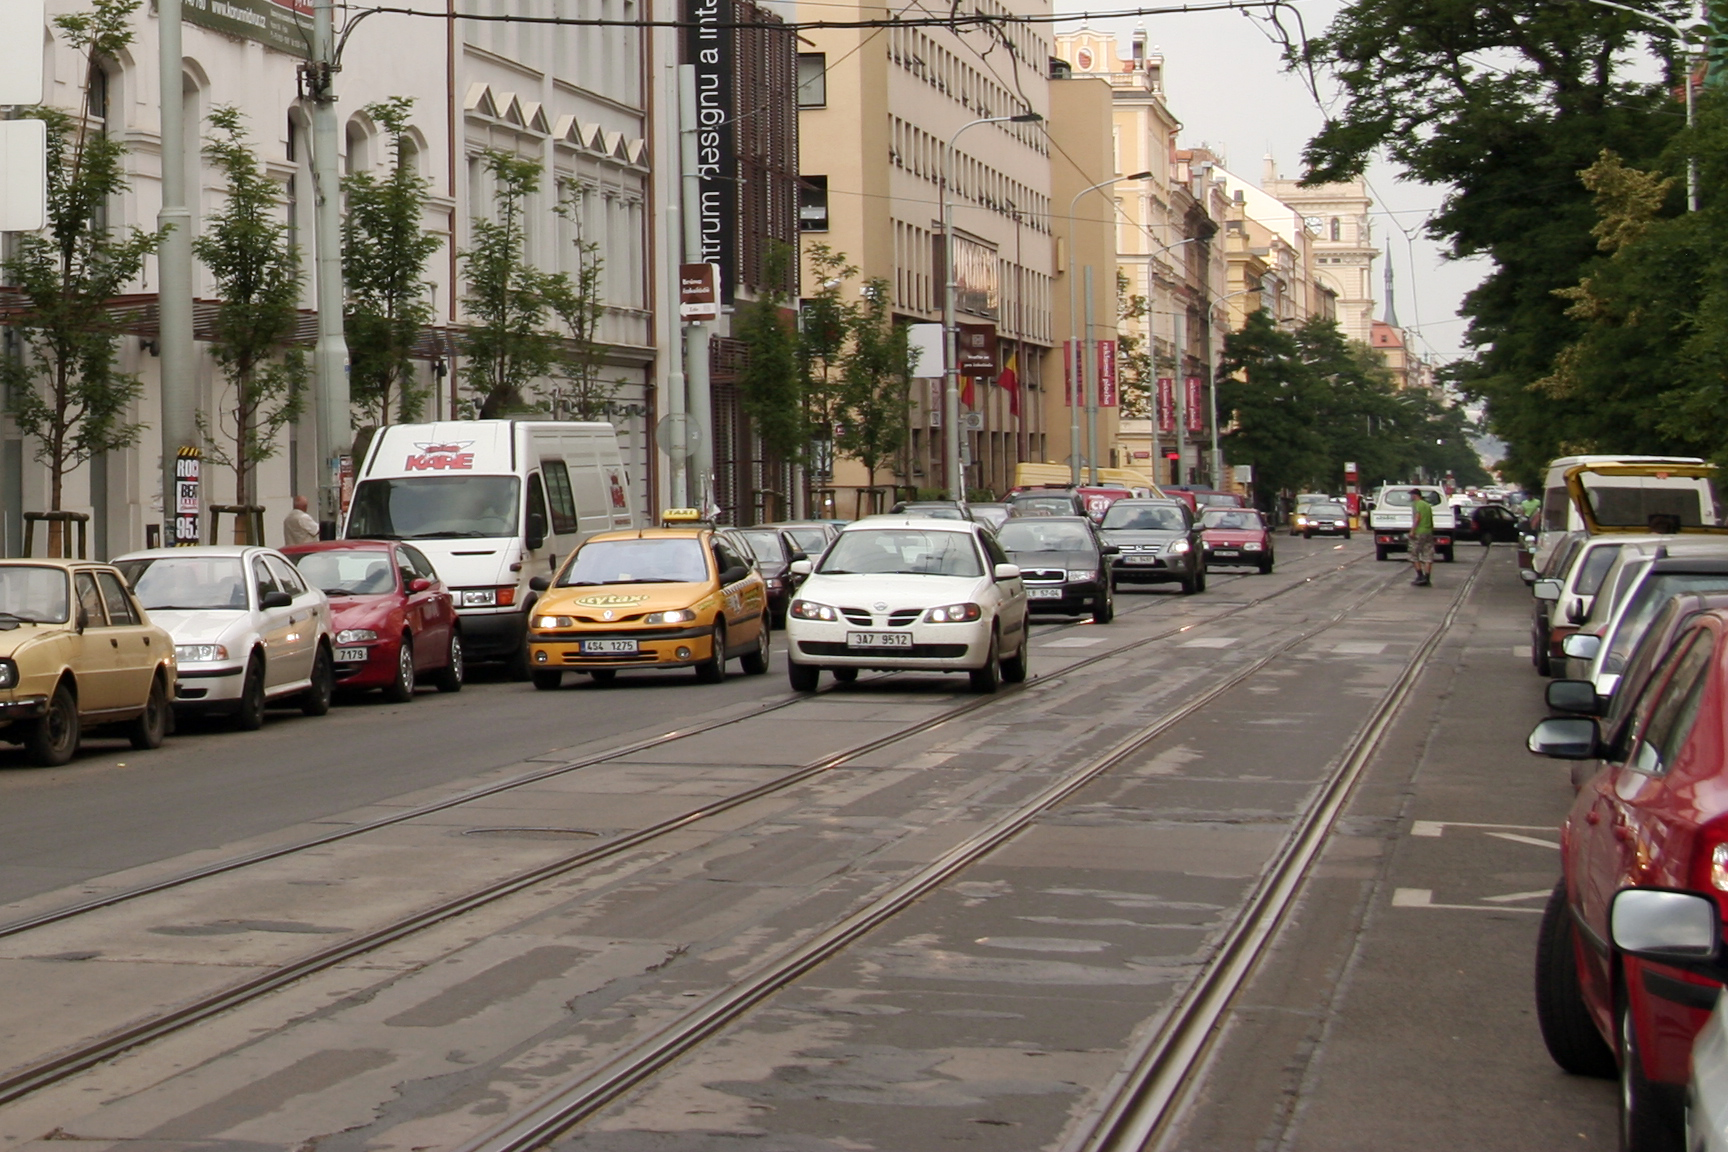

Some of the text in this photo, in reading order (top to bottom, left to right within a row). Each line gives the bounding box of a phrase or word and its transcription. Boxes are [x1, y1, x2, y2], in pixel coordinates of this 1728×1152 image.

[700, 47, 719, 64] a
[697, 74, 725, 181] designu
[701, 191, 721, 264] ntrum
[404, 453, 475, 471] KARE
[611, 641, 633, 651] 1275
[856, 634, 907, 645] 3A7 9512
[340, 649, 363, 660] 7179
